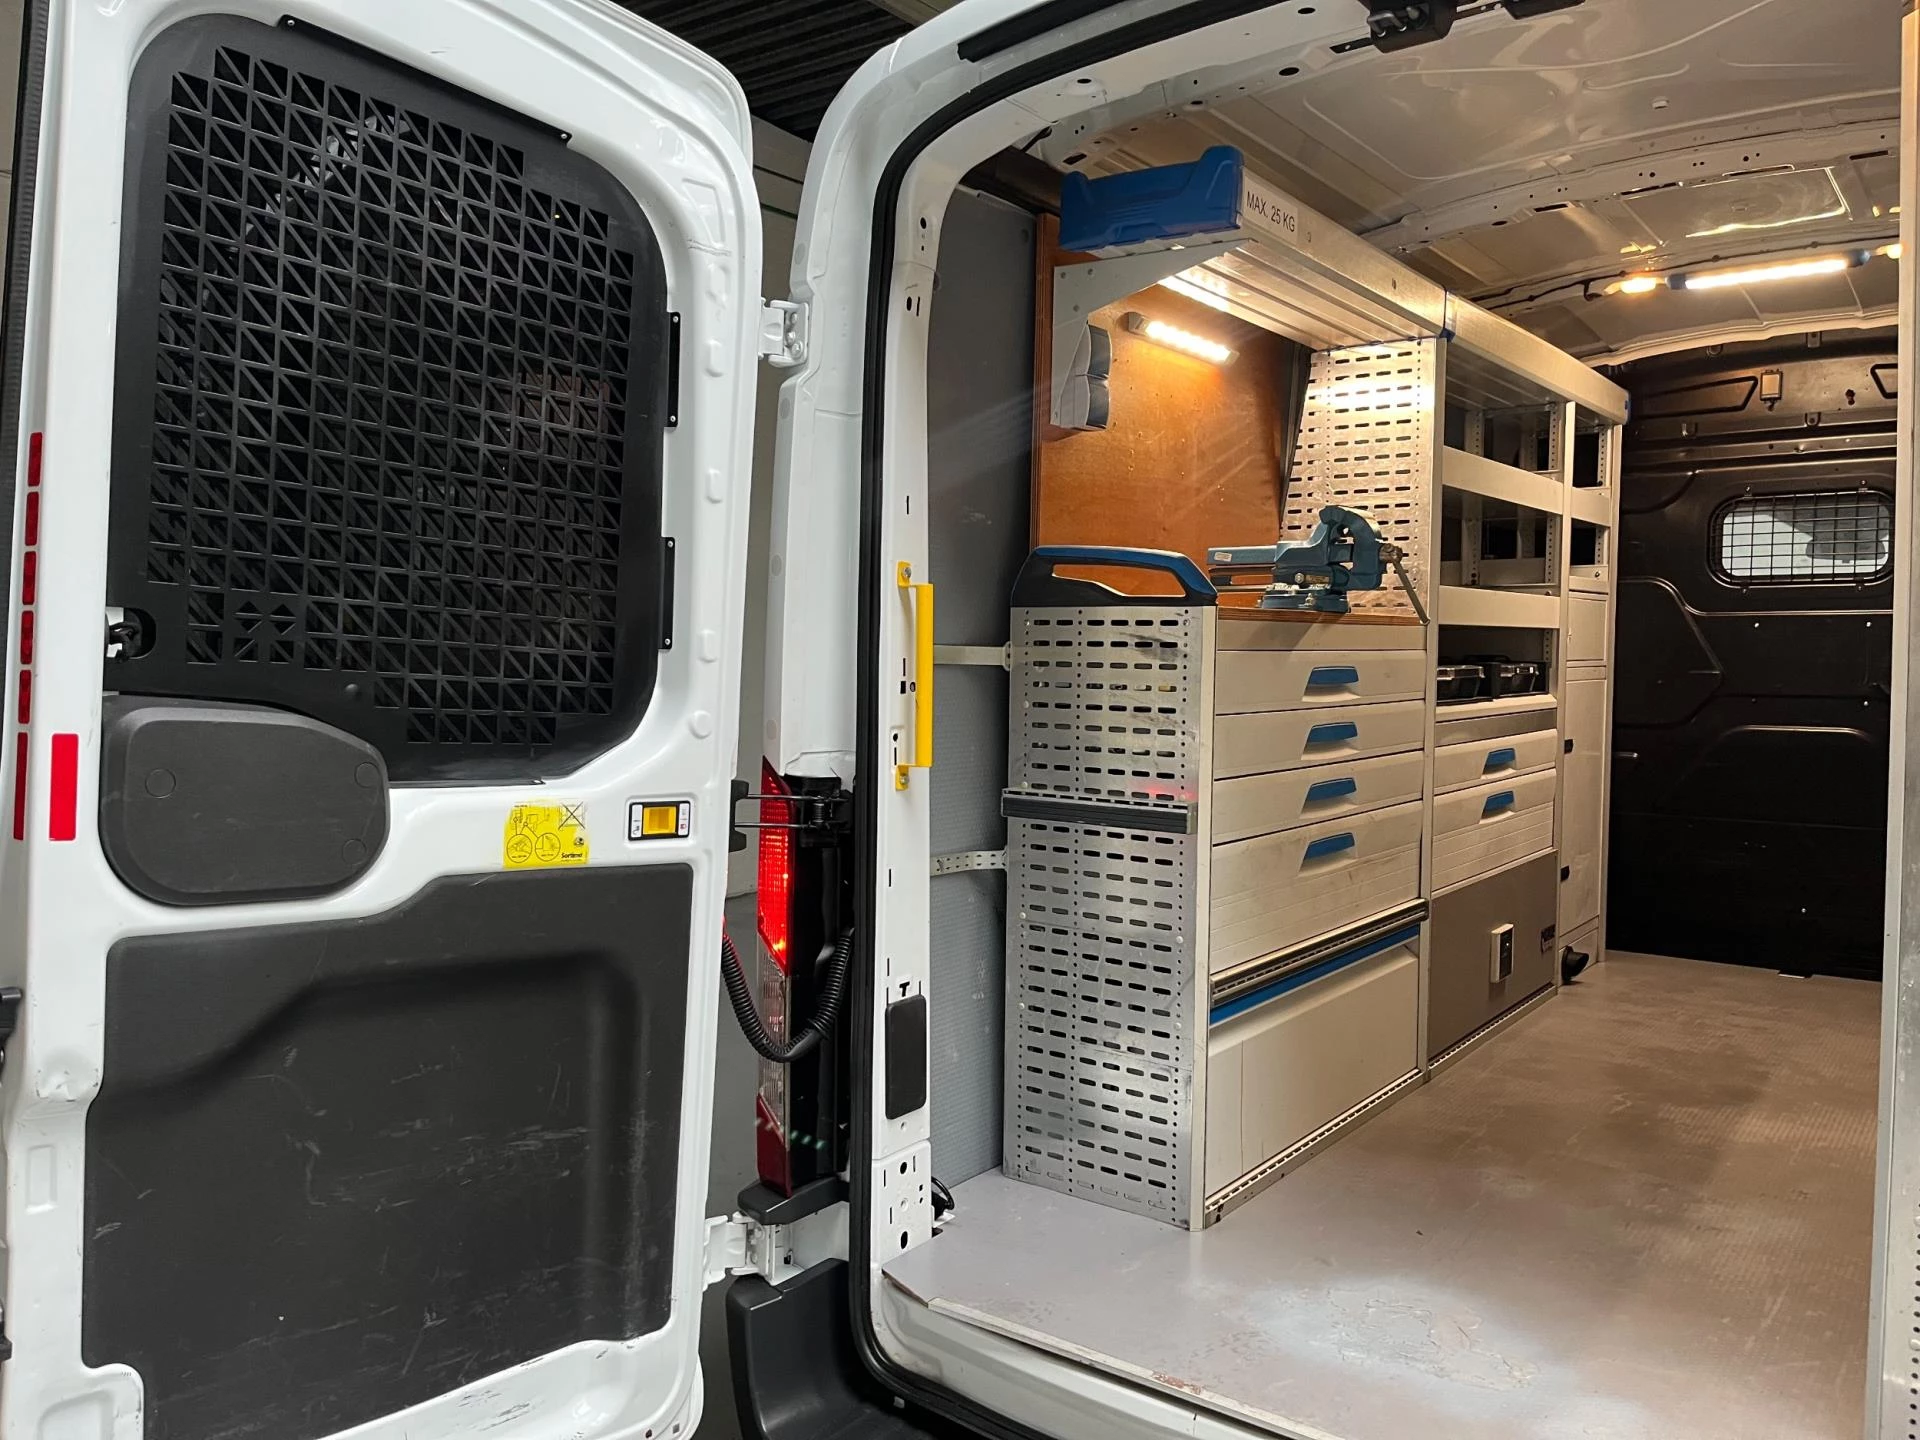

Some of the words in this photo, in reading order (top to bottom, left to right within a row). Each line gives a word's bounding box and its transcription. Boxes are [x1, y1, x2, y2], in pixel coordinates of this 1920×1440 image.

[1247, 191, 1268, 218] MAX.
[1271, 205, 1281, 225] 25
[1283, 212, 1295, 232] KG
